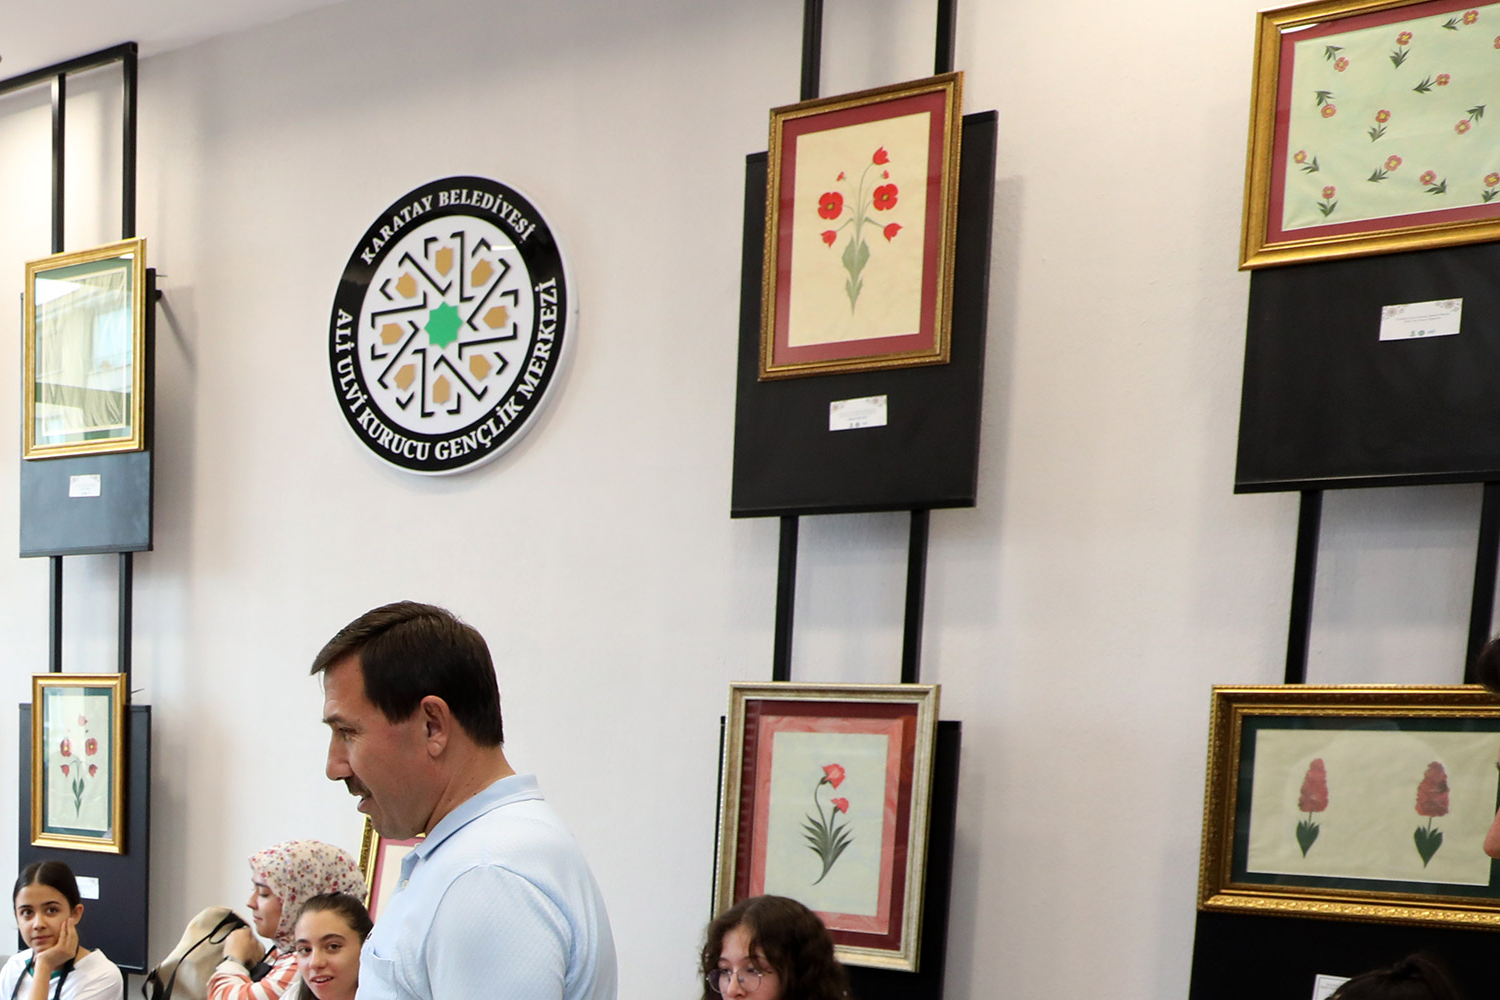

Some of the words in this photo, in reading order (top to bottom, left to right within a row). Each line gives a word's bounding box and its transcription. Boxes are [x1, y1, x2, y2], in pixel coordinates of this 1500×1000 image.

[361, 195, 433, 265] KARATAY
[438, 189, 535, 242] BELEDİYESİ
[336, 308, 355, 352] ALİ
[518, 277, 558, 400] MERKEZİ
[337, 355, 368, 414] ULVİ
[358, 410, 431, 461] KURUCU
[435, 397, 524, 460] GENÇLİK
